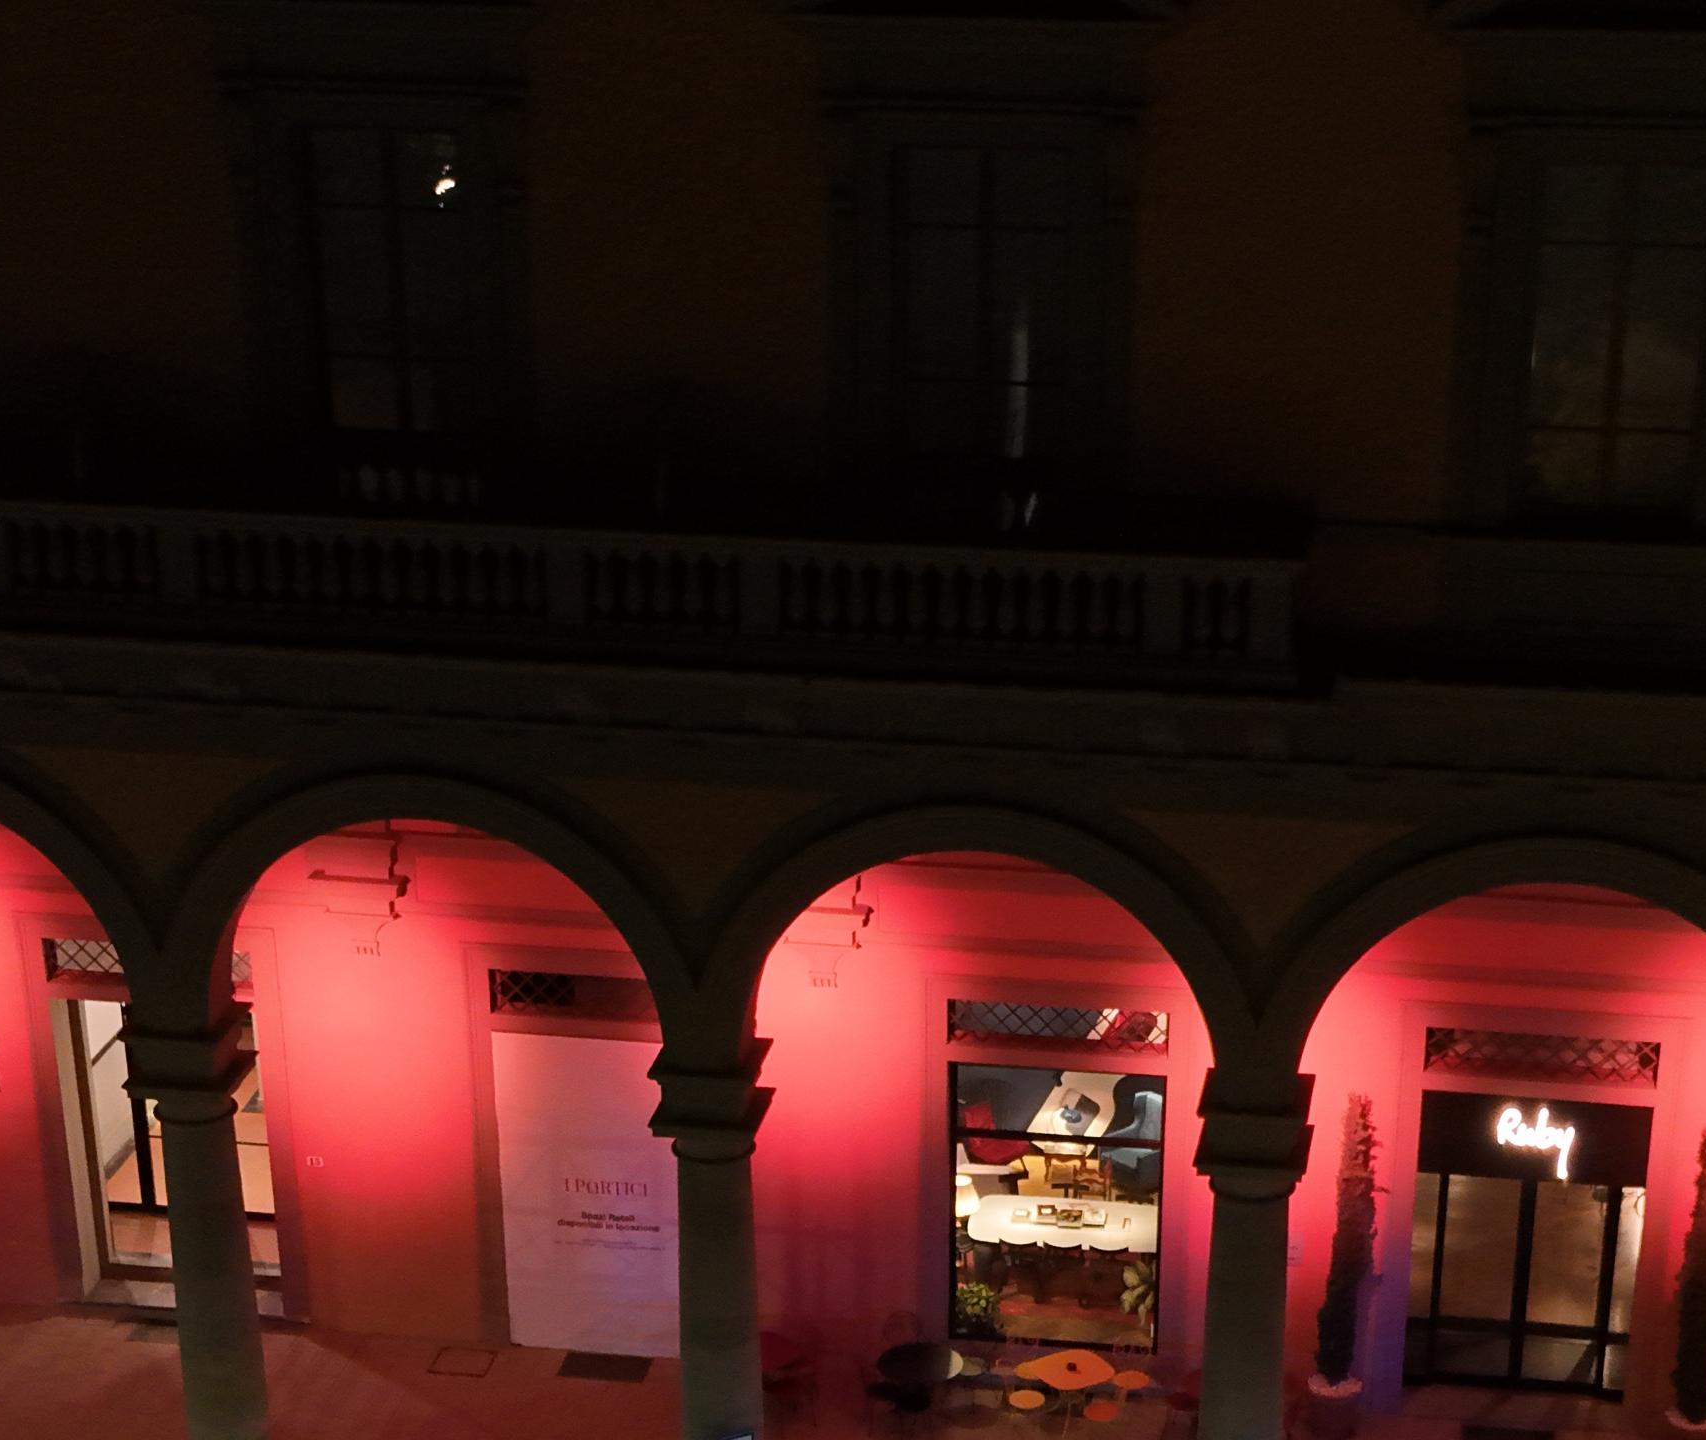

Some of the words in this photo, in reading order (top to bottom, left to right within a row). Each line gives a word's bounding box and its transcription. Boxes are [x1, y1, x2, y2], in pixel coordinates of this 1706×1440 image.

[1496, 1107, 1576, 1180] Ruby
[575, 1178, 648, 1197] PORTICI
[615, 1223, 660, 1233] locazione
